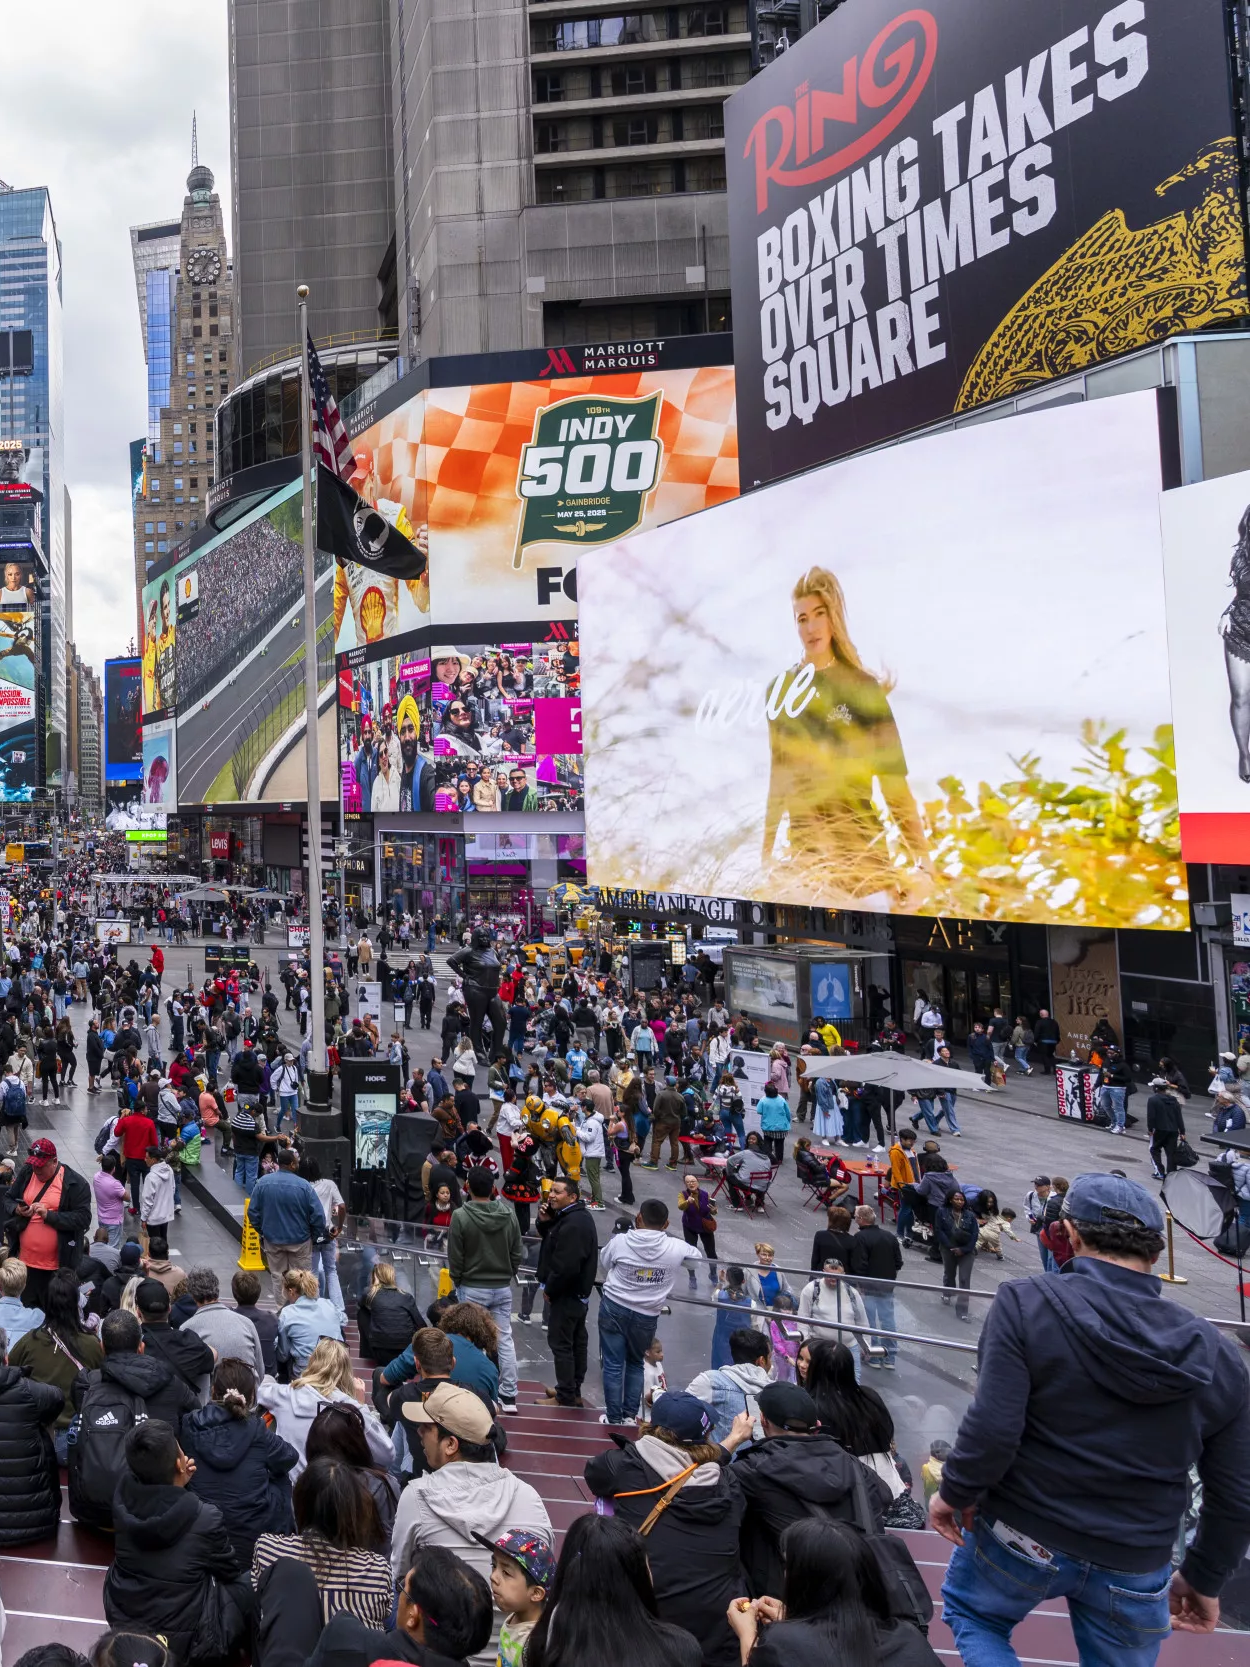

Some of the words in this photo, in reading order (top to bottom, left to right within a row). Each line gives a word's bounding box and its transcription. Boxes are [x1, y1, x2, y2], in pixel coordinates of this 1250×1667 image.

[794, 78, 810, 98] THE
[743, 9, 938, 215] RING
[757, 136, 920, 301] BOXING
[933, 0, 1150, 193] TAKES
[760, 246, 866, 365] OVER
[877, 142, 1057, 302] TIMES
[584, 341, 666, 357] MARRIOTT
[763, 281, 946, 431] SQUARE
[584, 353, 656, 371] MARQUIS
[350, 401, 377, 425] MARRIOTT
[350, 415, 374, 436] MARQUIS
[558, 413, 637, 443] INDY
[520, 439, 659, 498] 500
[565, 496, 611, 507] GAINBRIDGE
[557, 510, 574, 519] MAY
[574, 509, 586, 519] 25,
[587, 508, 607, 518] 2025
[402, 665, 414, 677] TIMES
[413, 663, 429, 675] SQUARE
[599, 887, 680, 915] AMERICAN
[1067, 966, 1105, 981] live
[1055, 979, 1114, 997] your
[1067, 995, 1108, 1018] life
[95, 1417, 119, 1426] adidas
